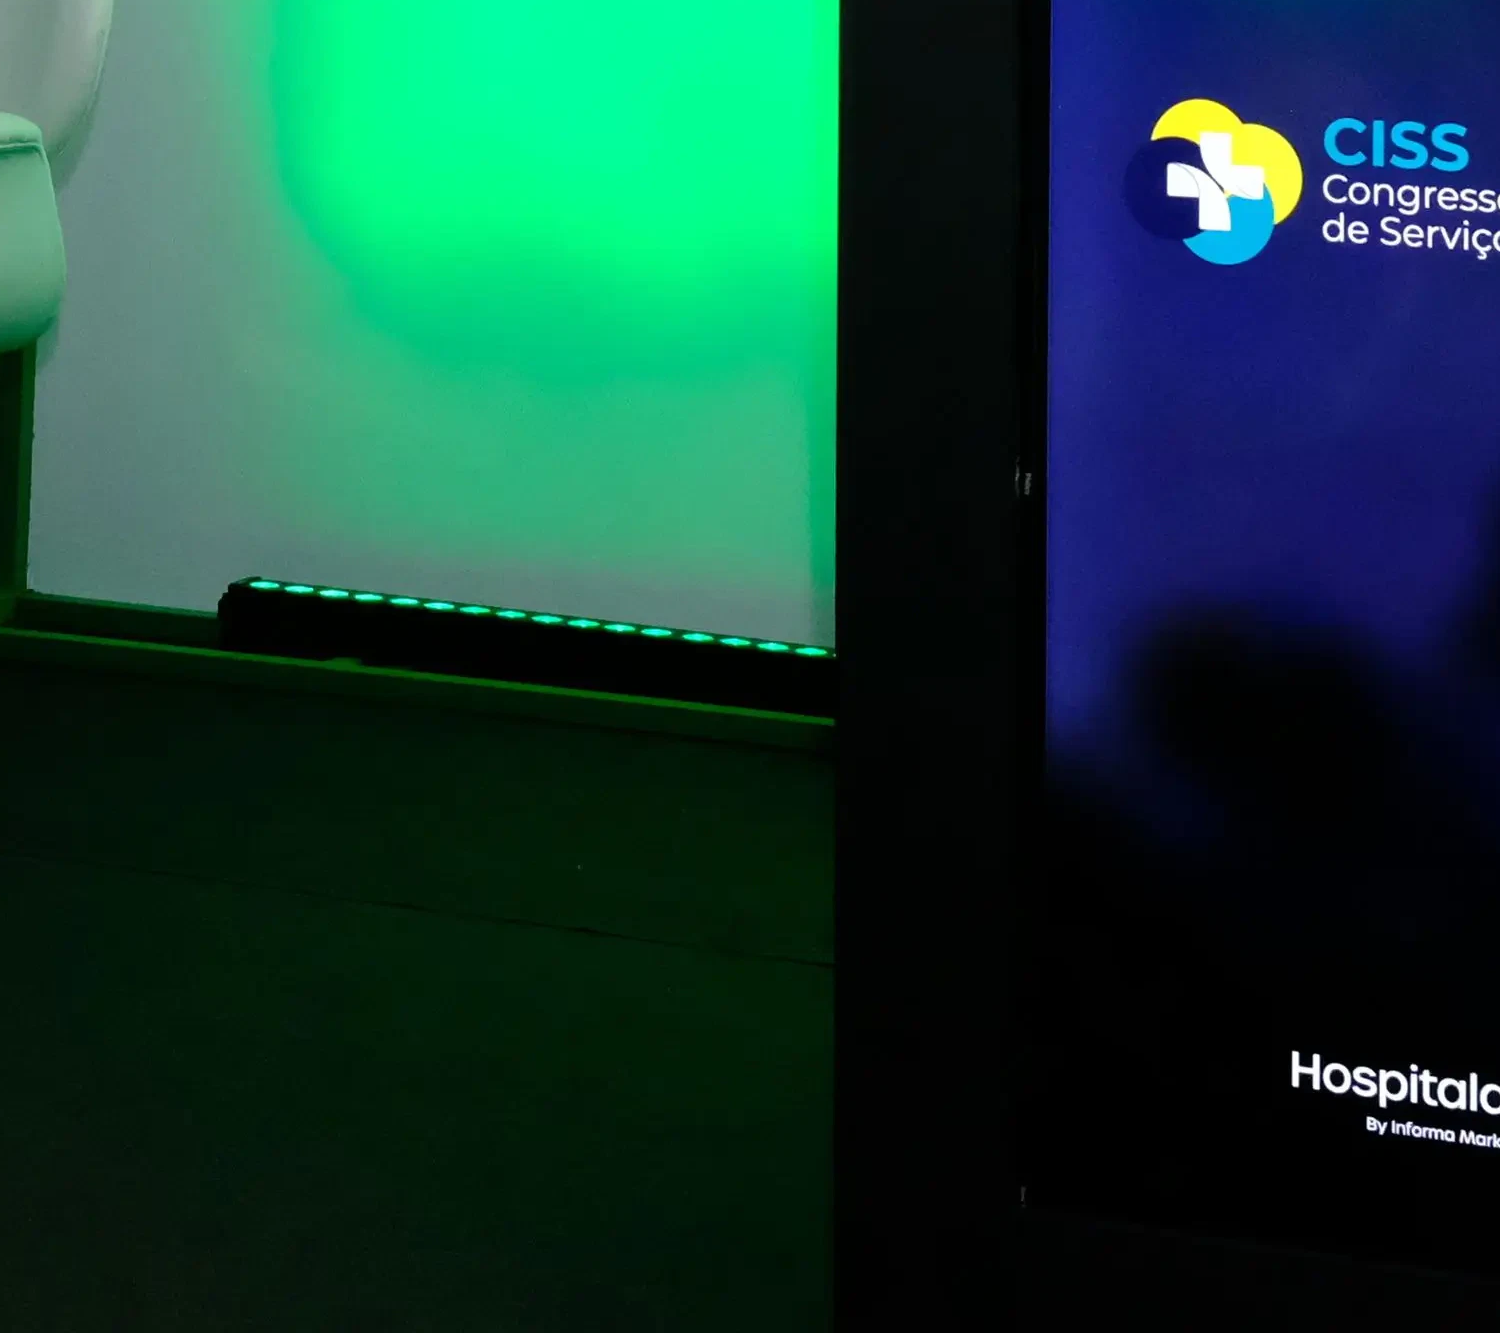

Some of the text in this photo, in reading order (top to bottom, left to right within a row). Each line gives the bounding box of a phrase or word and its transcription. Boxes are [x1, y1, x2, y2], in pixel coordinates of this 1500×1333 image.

[1323, 116, 1471, 172] CISS
[1321, 212, 1370, 245] de
[1366, 1116, 1388, 1135] By
[1391, 1119, 1456, 1143] Informa
